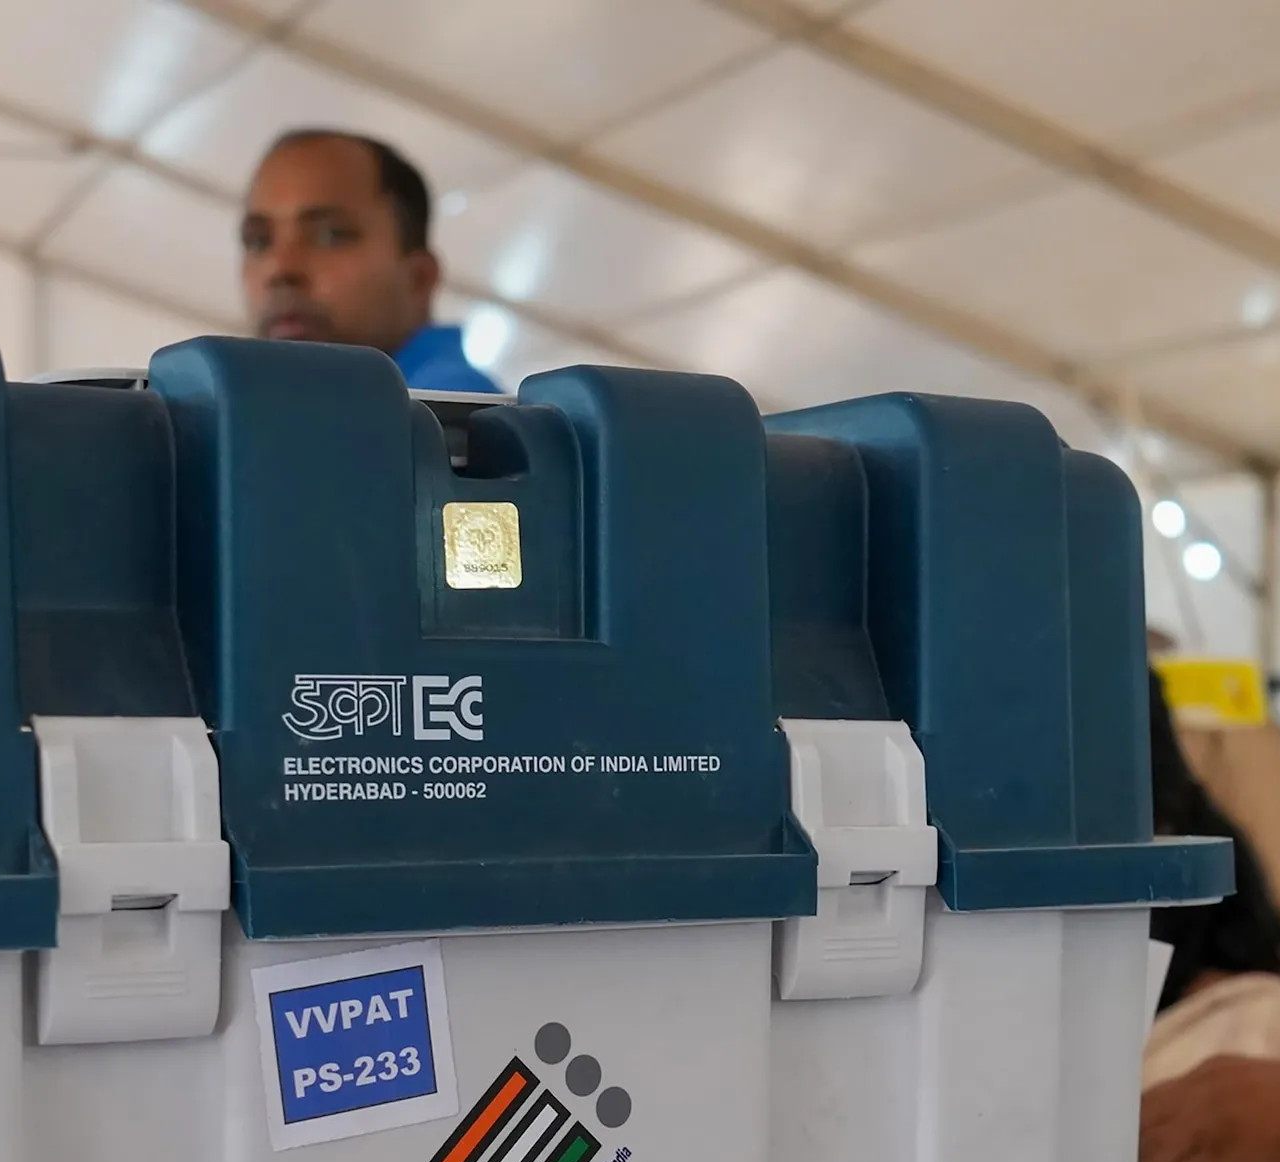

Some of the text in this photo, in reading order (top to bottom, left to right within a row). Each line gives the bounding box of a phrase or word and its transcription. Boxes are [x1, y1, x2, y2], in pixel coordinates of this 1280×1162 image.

[284, 755, 721, 775] ELECTRONICS CORPORATION OF INDIA LIMITED
[284, 783, 407, 801] HYDERABAD
[423, 783, 487, 799] 500062
[284, 988, 414, 1040] VVPAT
[292, 1046, 421, 1099] PS-233
